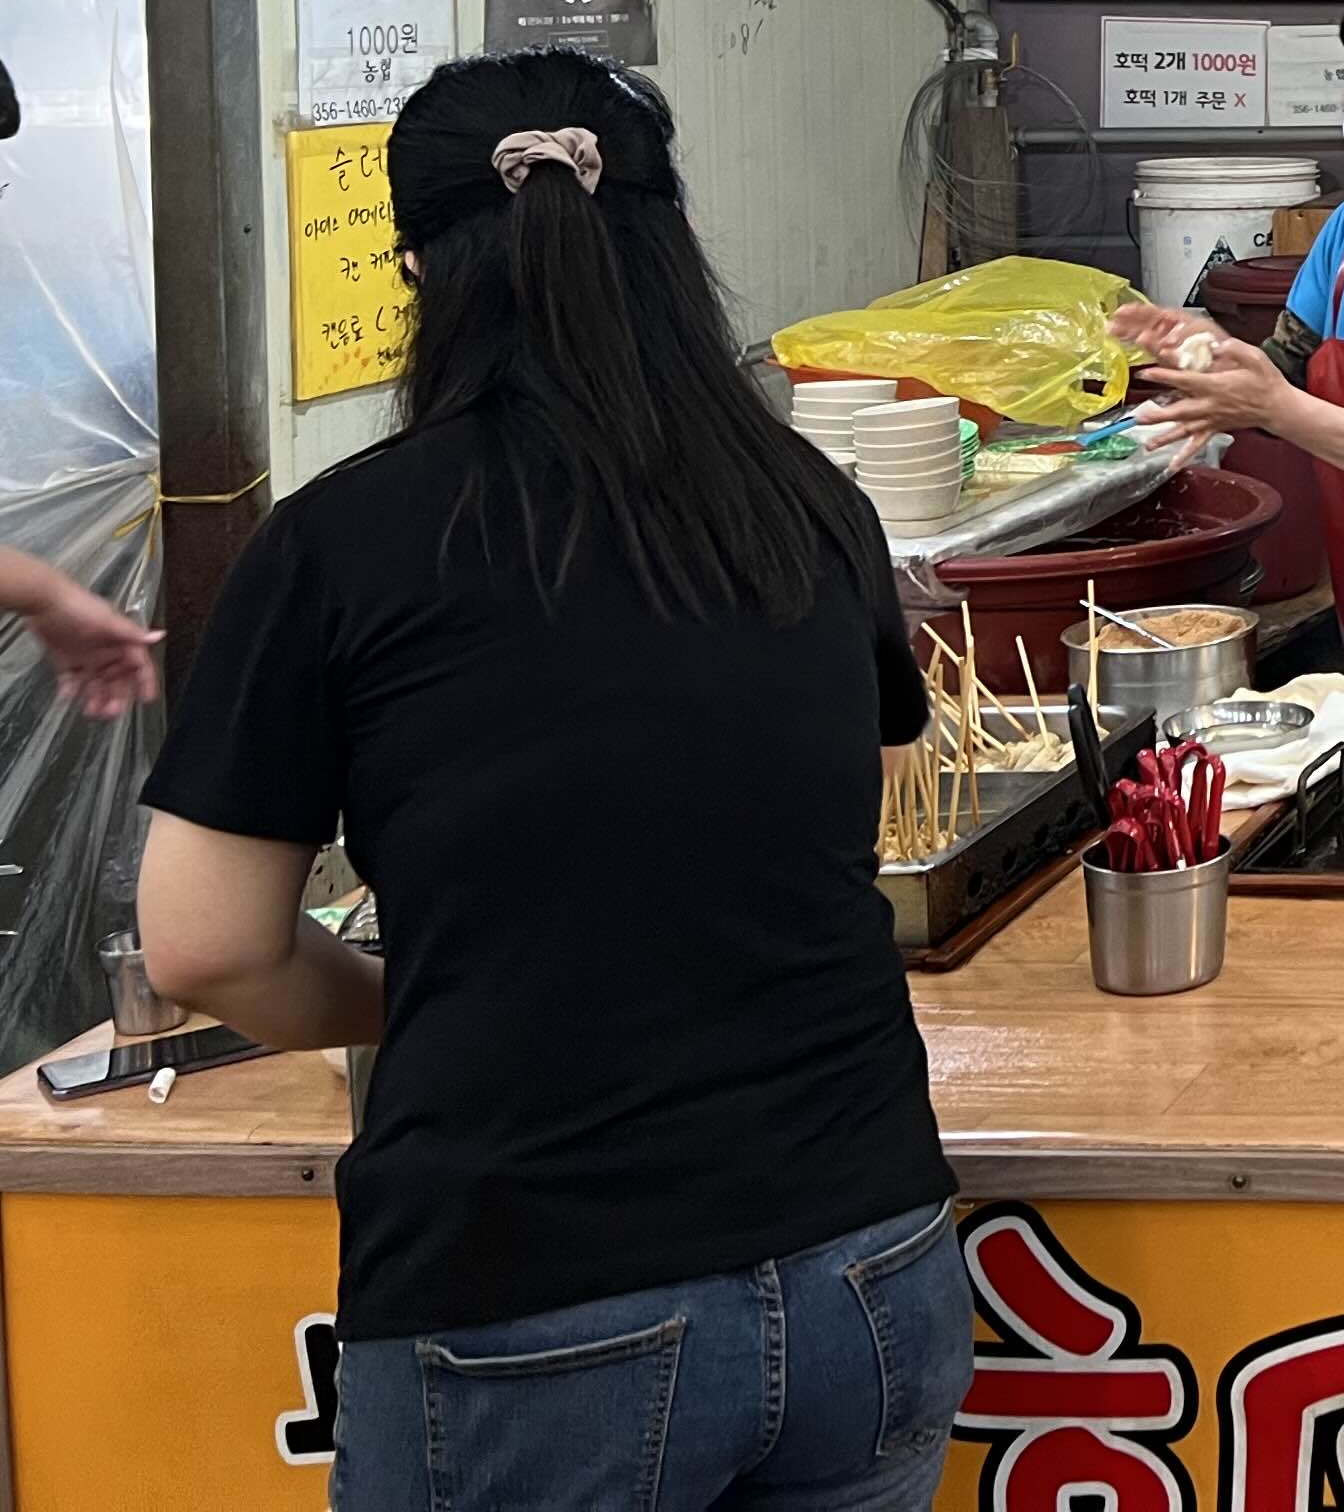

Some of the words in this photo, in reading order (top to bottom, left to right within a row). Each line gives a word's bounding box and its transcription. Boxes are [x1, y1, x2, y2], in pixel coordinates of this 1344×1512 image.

[347, 23, 418, 57] 1000원
[362, 58, 392, 83] 농협
[1113, 52, 1148, 72] 호떡
[1154, 52, 1186, 71] 2개
[1192, 53, 1257, 76] 1000원
[1123, 88, 1156, 107] 호떡
[1163, 90, 1187, 106] 1개
[1195, 91, 1226, 110] 주문
[1234, 93, 1246, 107] X
[329, 145, 386, 191] 슬러
